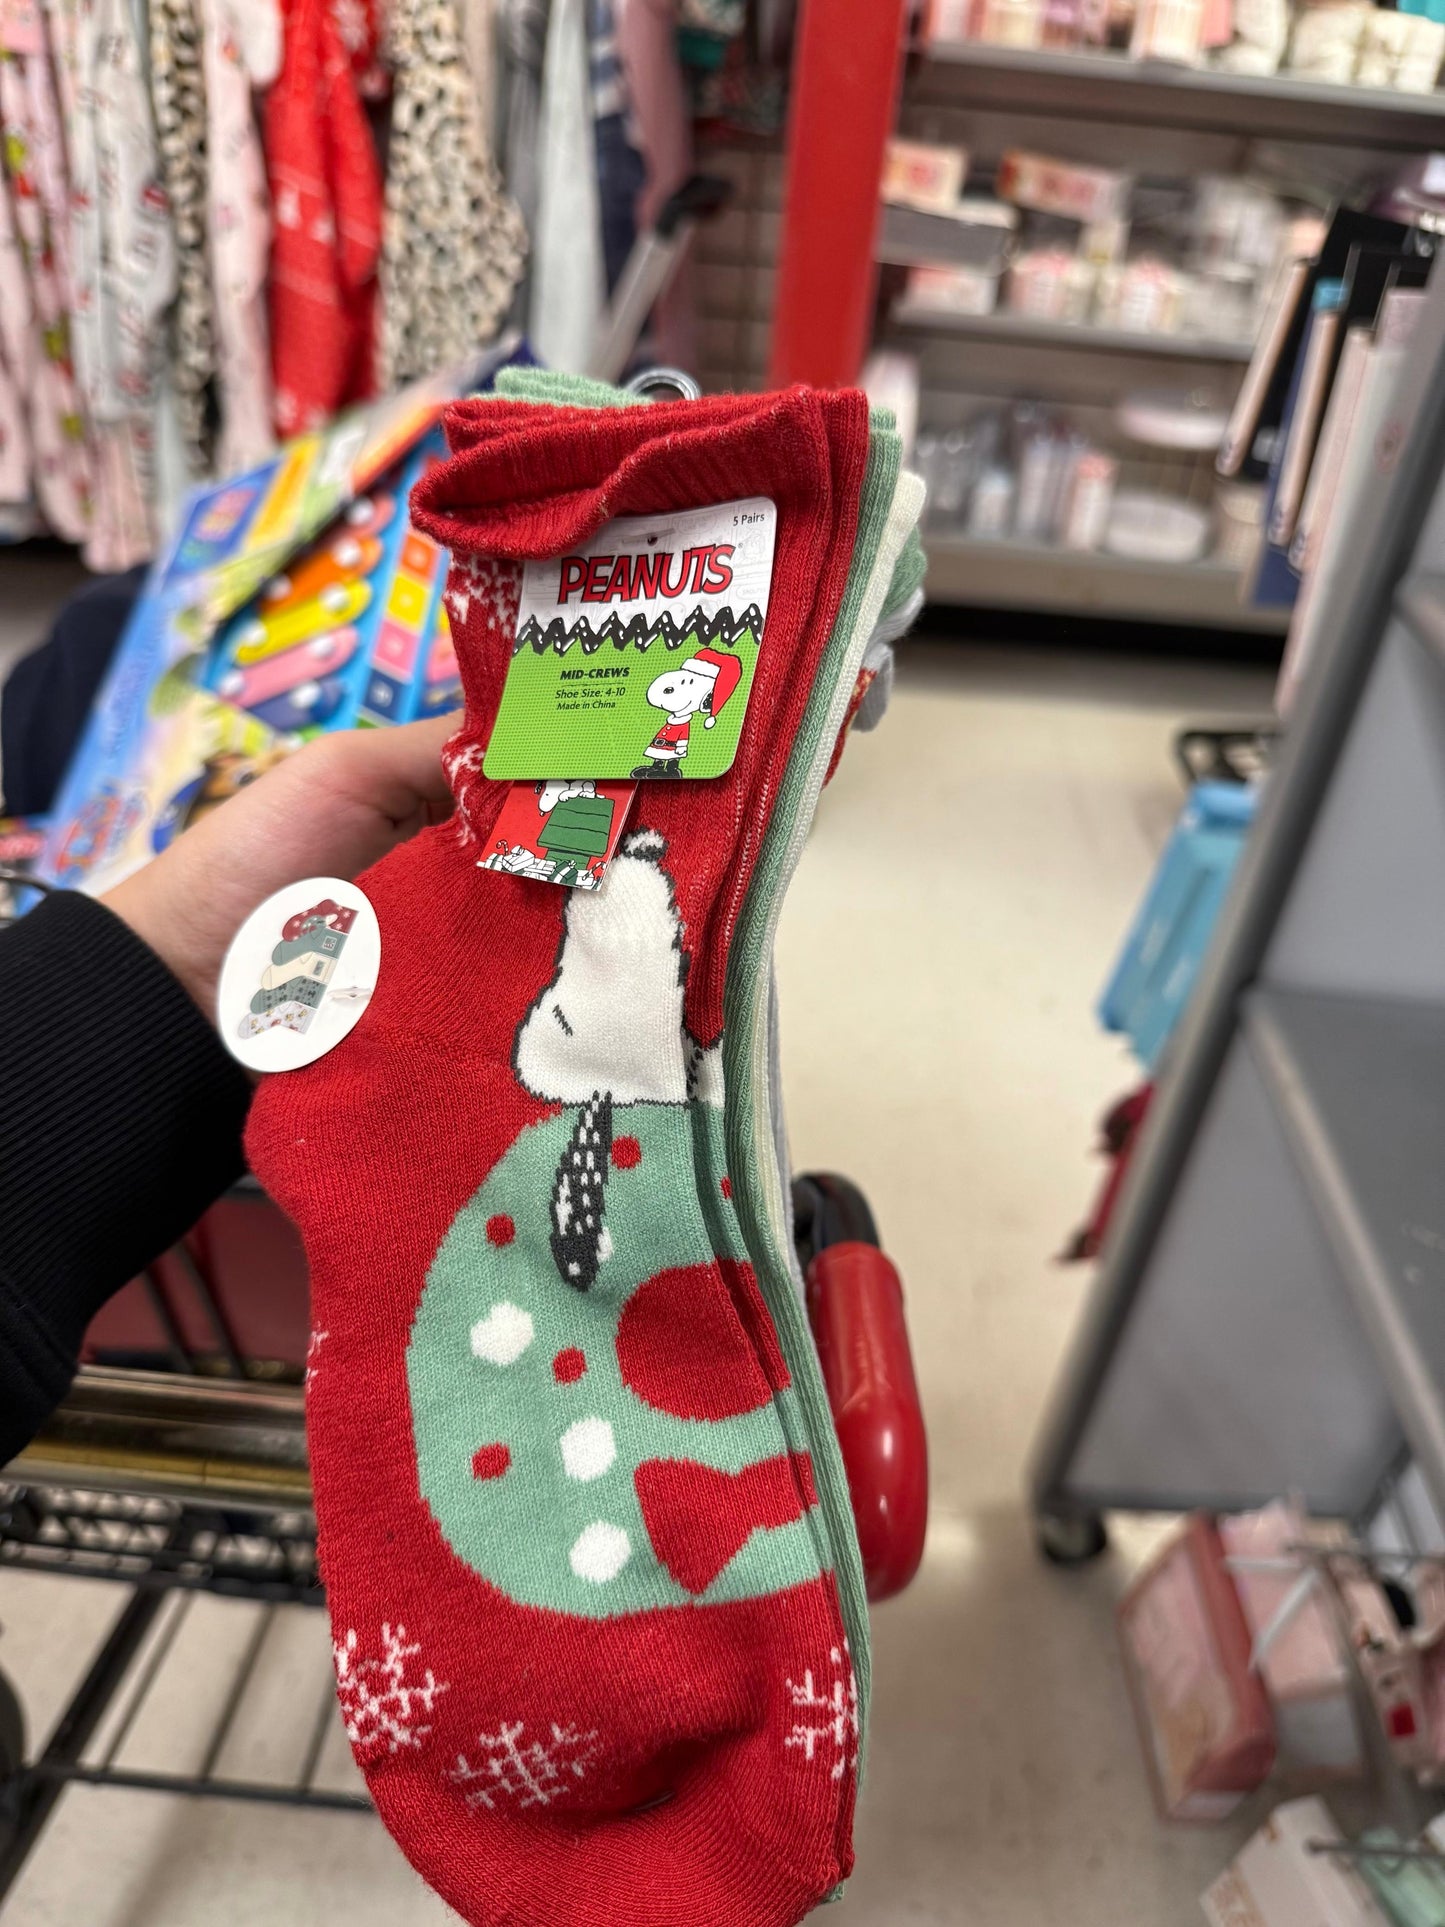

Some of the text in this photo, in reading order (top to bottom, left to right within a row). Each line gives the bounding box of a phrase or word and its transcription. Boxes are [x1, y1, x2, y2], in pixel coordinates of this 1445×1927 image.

[732, 512, 765, 526] 5 Pairs
[557, 543, 737, 605] PEANUTS
[560, 667, 630, 680] MID-CREWS
[555, 687, 626, 699] Shoe Size: 4-10
[557, 700, 616, 711] Made in China
